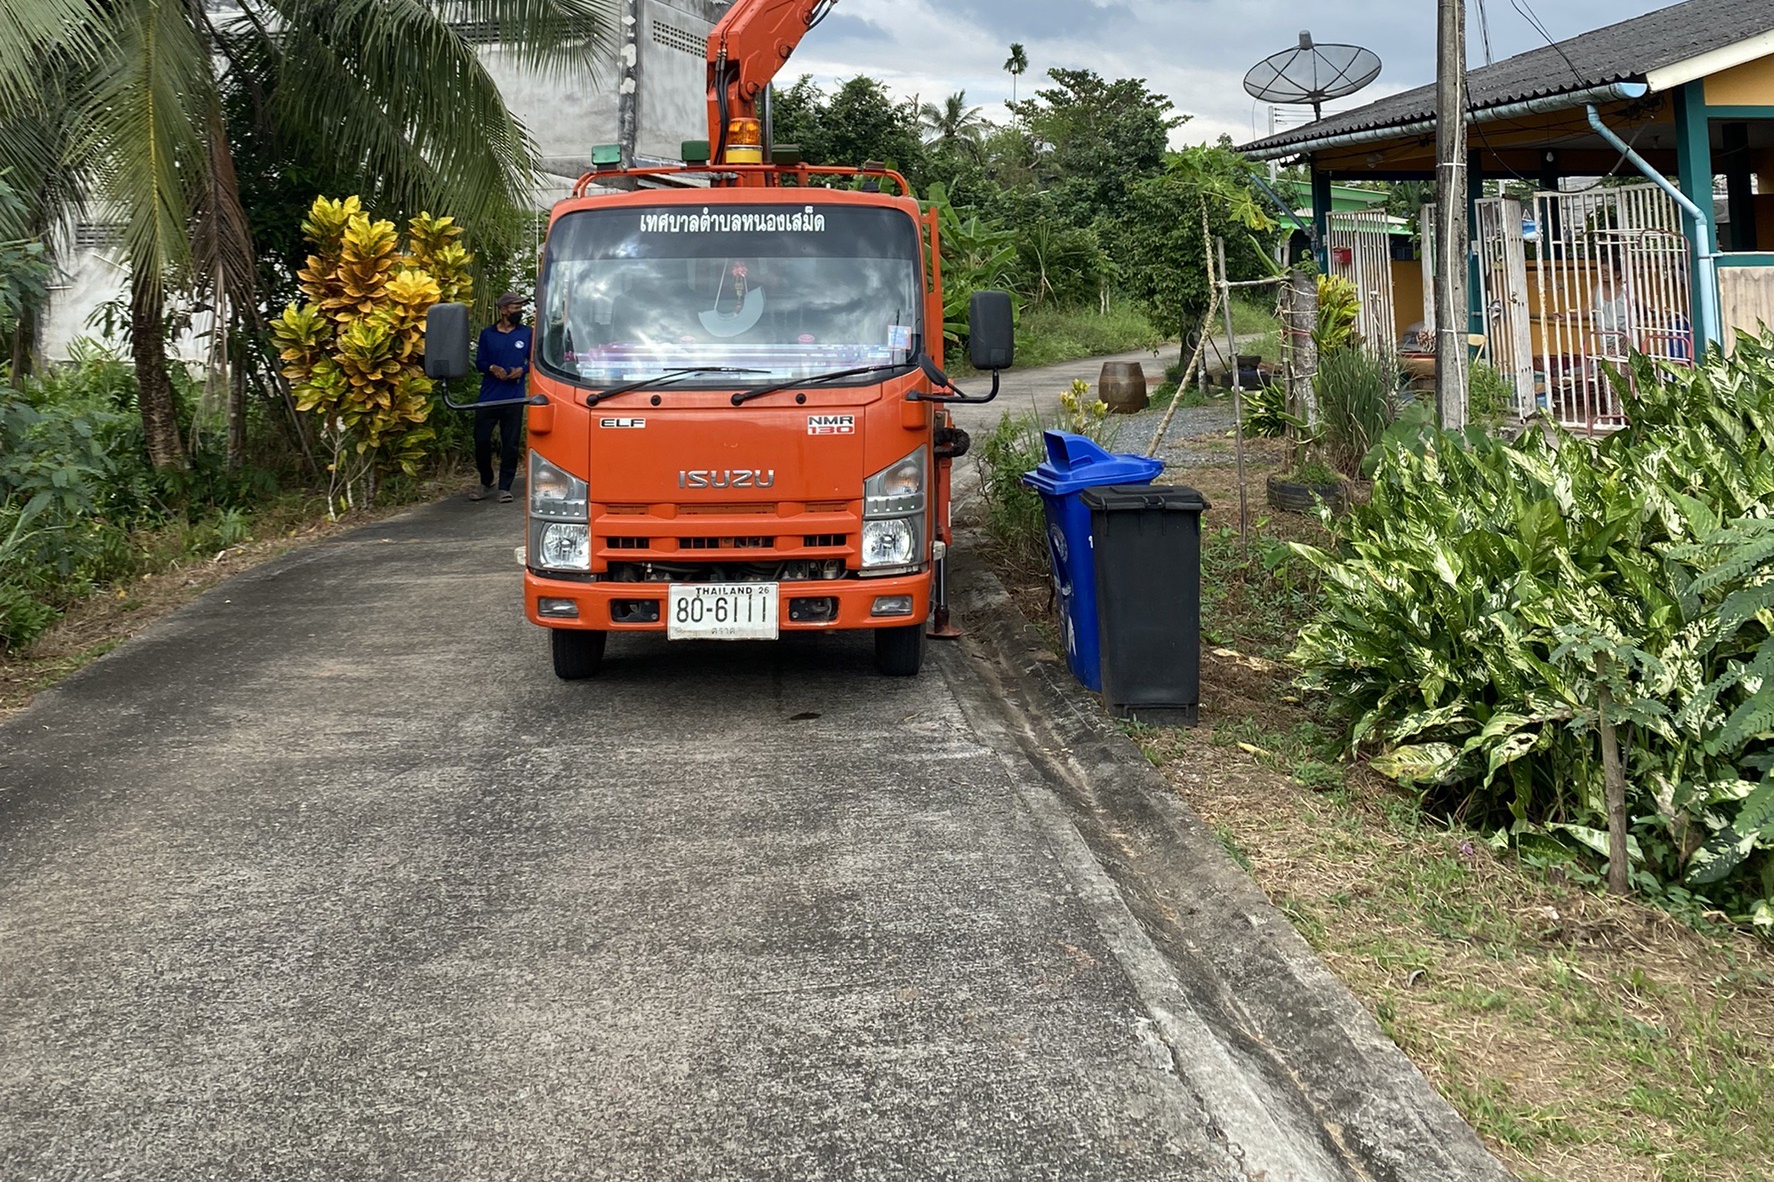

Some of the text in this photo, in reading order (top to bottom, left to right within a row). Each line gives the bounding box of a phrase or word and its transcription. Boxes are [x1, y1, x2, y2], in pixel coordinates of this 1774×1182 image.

[640, 205, 826, 233] เทศบาลตำบลหนองเสม็ด
[600, 418, 645, 428] ELF
[808, 415, 854, 425] NMR
[808, 425, 854, 434] 130
[678, 469, 775, 489] ISUZU
[695, 586, 770, 595] THAILAND 26
[676, 596, 767, 623] 80-6111
